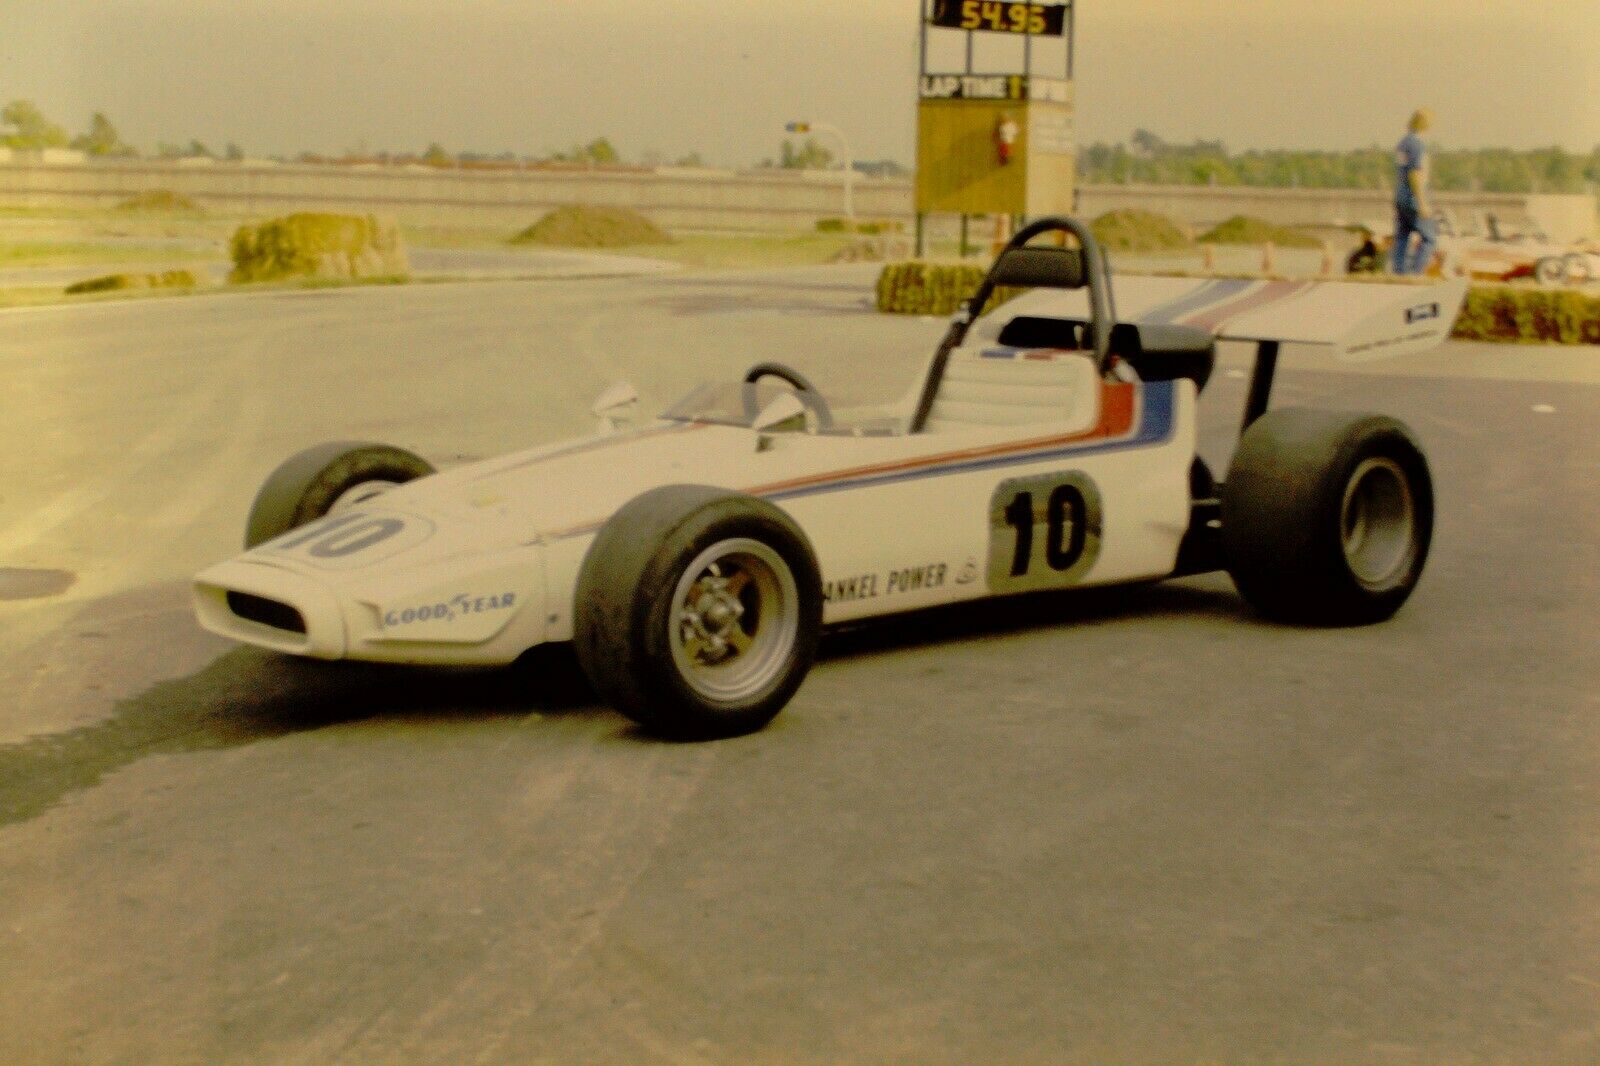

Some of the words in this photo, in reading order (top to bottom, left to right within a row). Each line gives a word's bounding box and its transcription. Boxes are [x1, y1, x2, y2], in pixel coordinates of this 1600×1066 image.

[920, 76, 961, 97] LAP
[962, 77, 1007, 98] TIME
[1005, 484, 1087, 577] 10
[822, 573, 877, 602] ANKEL
[886, 562, 948, 595] POWER
